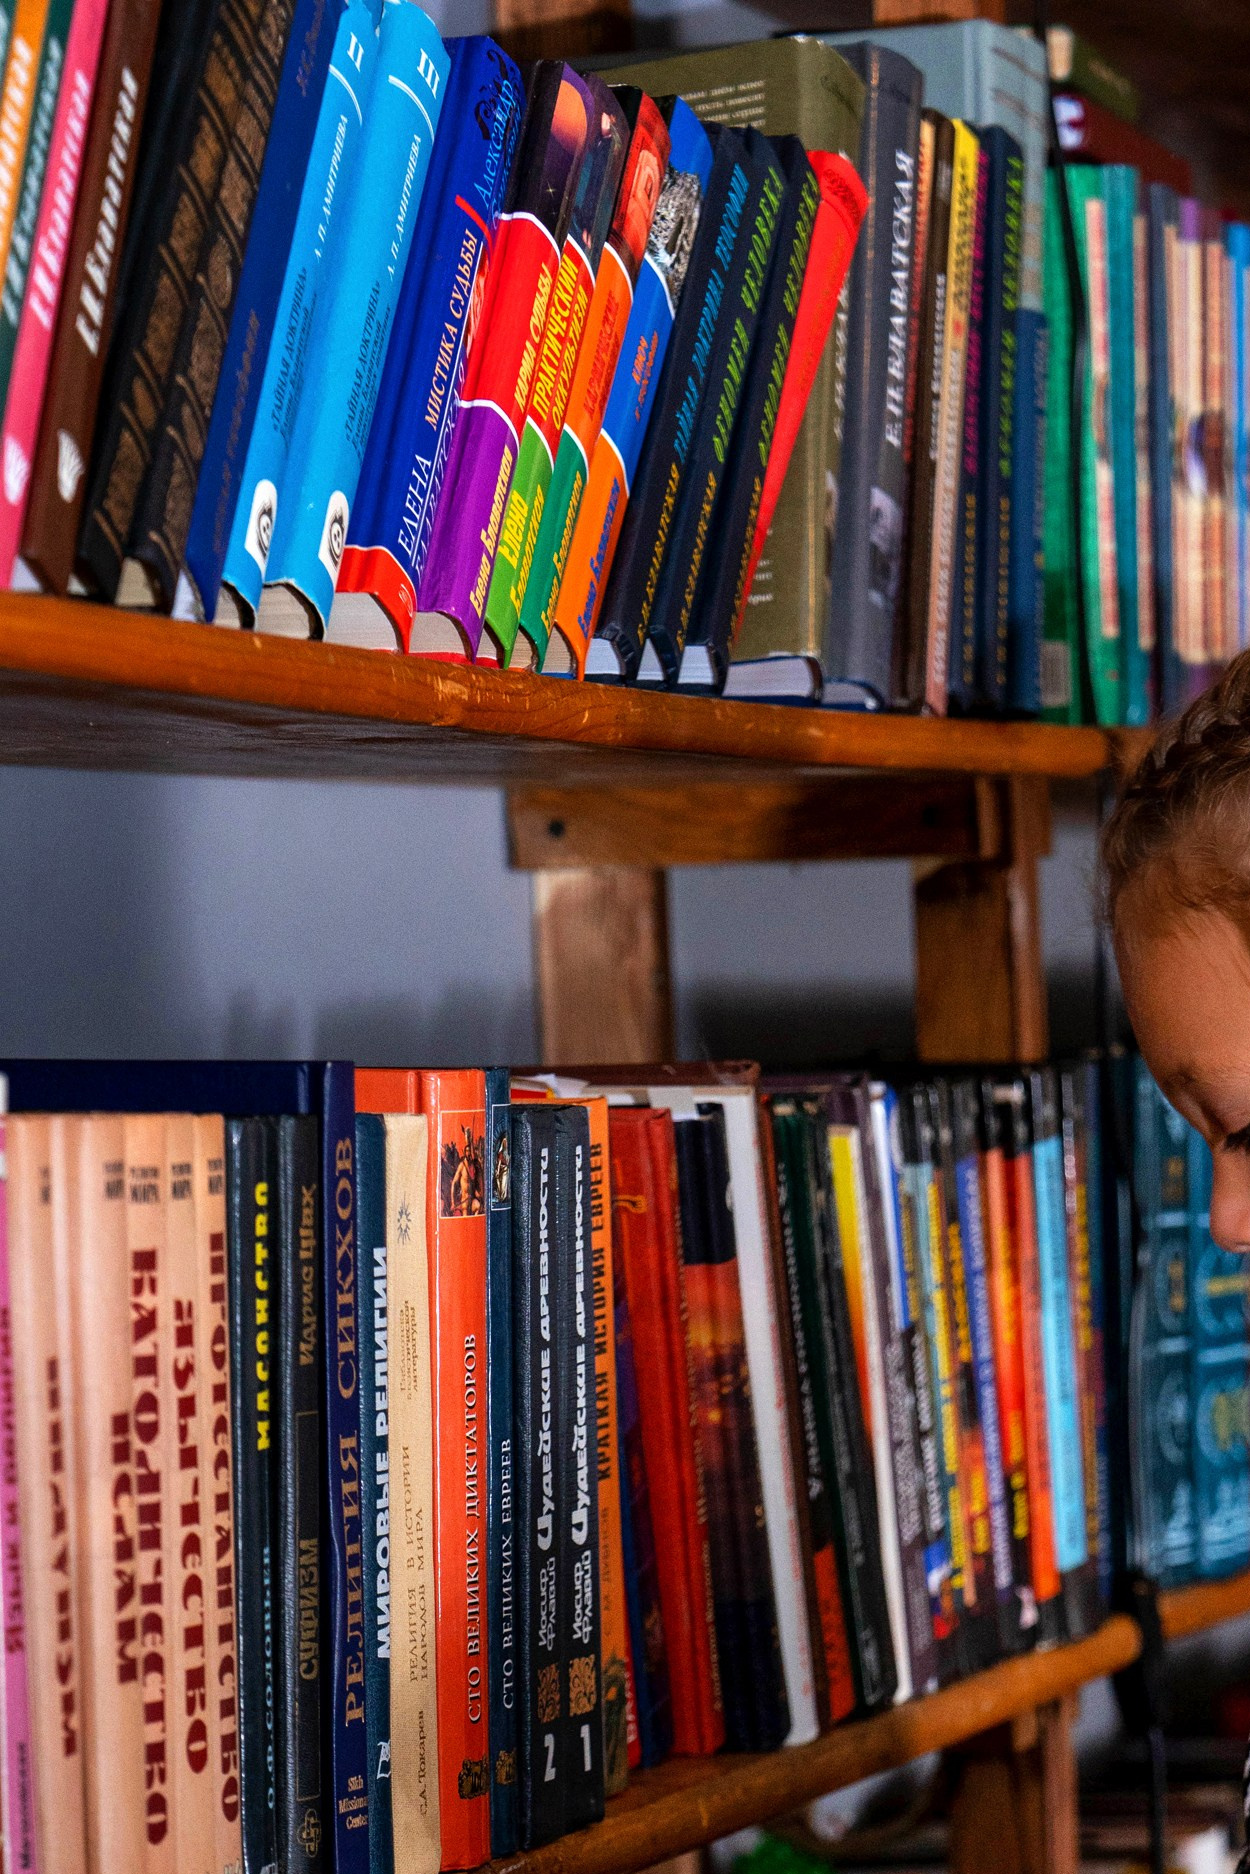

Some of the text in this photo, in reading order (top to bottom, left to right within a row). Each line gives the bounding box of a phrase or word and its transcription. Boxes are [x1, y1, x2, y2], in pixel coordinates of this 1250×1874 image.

[417, 48, 441, 97] III
[470, 77, 519, 208] Александр
[321, 114, 347, 224] ДМИТРИЕВА
[395, 133, 420, 242] ДМИТРИЕВА
[341, 279, 381, 440] «ТАЙНАЯ ДОКТРИНА»
[423, 227, 478, 431] МИСТИКА СУДЬБЫ
[513, 262, 551, 412] КАРМА СУДЬБЫ
[531, 253, 579, 420] ПРАКТИЧЕСКИЙ
[552, 285, 589, 433] ОККУЛЬТИЗМ
[631, 335, 649, 385] КЛЮЧ
[710, 316, 751, 464] ФЕНОМЕН
[741, 168, 783, 315] ЧЕЛОВЕКА
[756, 169, 819, 468] ФЕНОМЕН ЧЕЛОВЕКА
[398, 453, 430, 556] ЕЛЕНА
[497, 490, 529, 571] Елена
[254, 1180, 271, 1451] МАСОНСТВО
[298, 1184, 317, 1367] Идрис Шах
[588, 1141, 611, 1482] КРАТКАЯ ИСТОРИЯ ЕВРЕЕВ
[335, 1138, 364, 1727] РЕЛИГИЯ СИКХОВ
[373, 1247, 391, 1659] МИРОВЫЕ РЕЛИГИИ
[131, 1248, 168, 1846] КАТОЛИЧЕСТВО
[172, 1298, 208, 1775] ЯЗЫЧЕСТВО
[209, 1231, 240, 1823] ПРОТЕСТАНТСТВО
[401, 1445, 418, 1682] РЕЛИГИЯ В ИСТОРИИ
[415, 1507, 429, 1681] НАРОДОВ МИРА
[462, 1333, 481, 1725] СТО ВЕЛИКИХ ДИКТАТОРОВ
[499, 1439, 514, 1709] СТО ВЕЛИКИХ ЕВРЕЕВ
[544, 1555, 556, 1651] Флавий
[571, 1561, 583, 1639] Иосиф
[579, 1549, 592, 1644] Флавий
[299, 1537, 319, 1681] СУФИЗМ
[537, 1568, 549, 1646] Иосиф
[348, 1775, 364, 1792] Sikh
[543, 1733, 557, 1782] 2
[580, 1724, 591, 1772] 1
